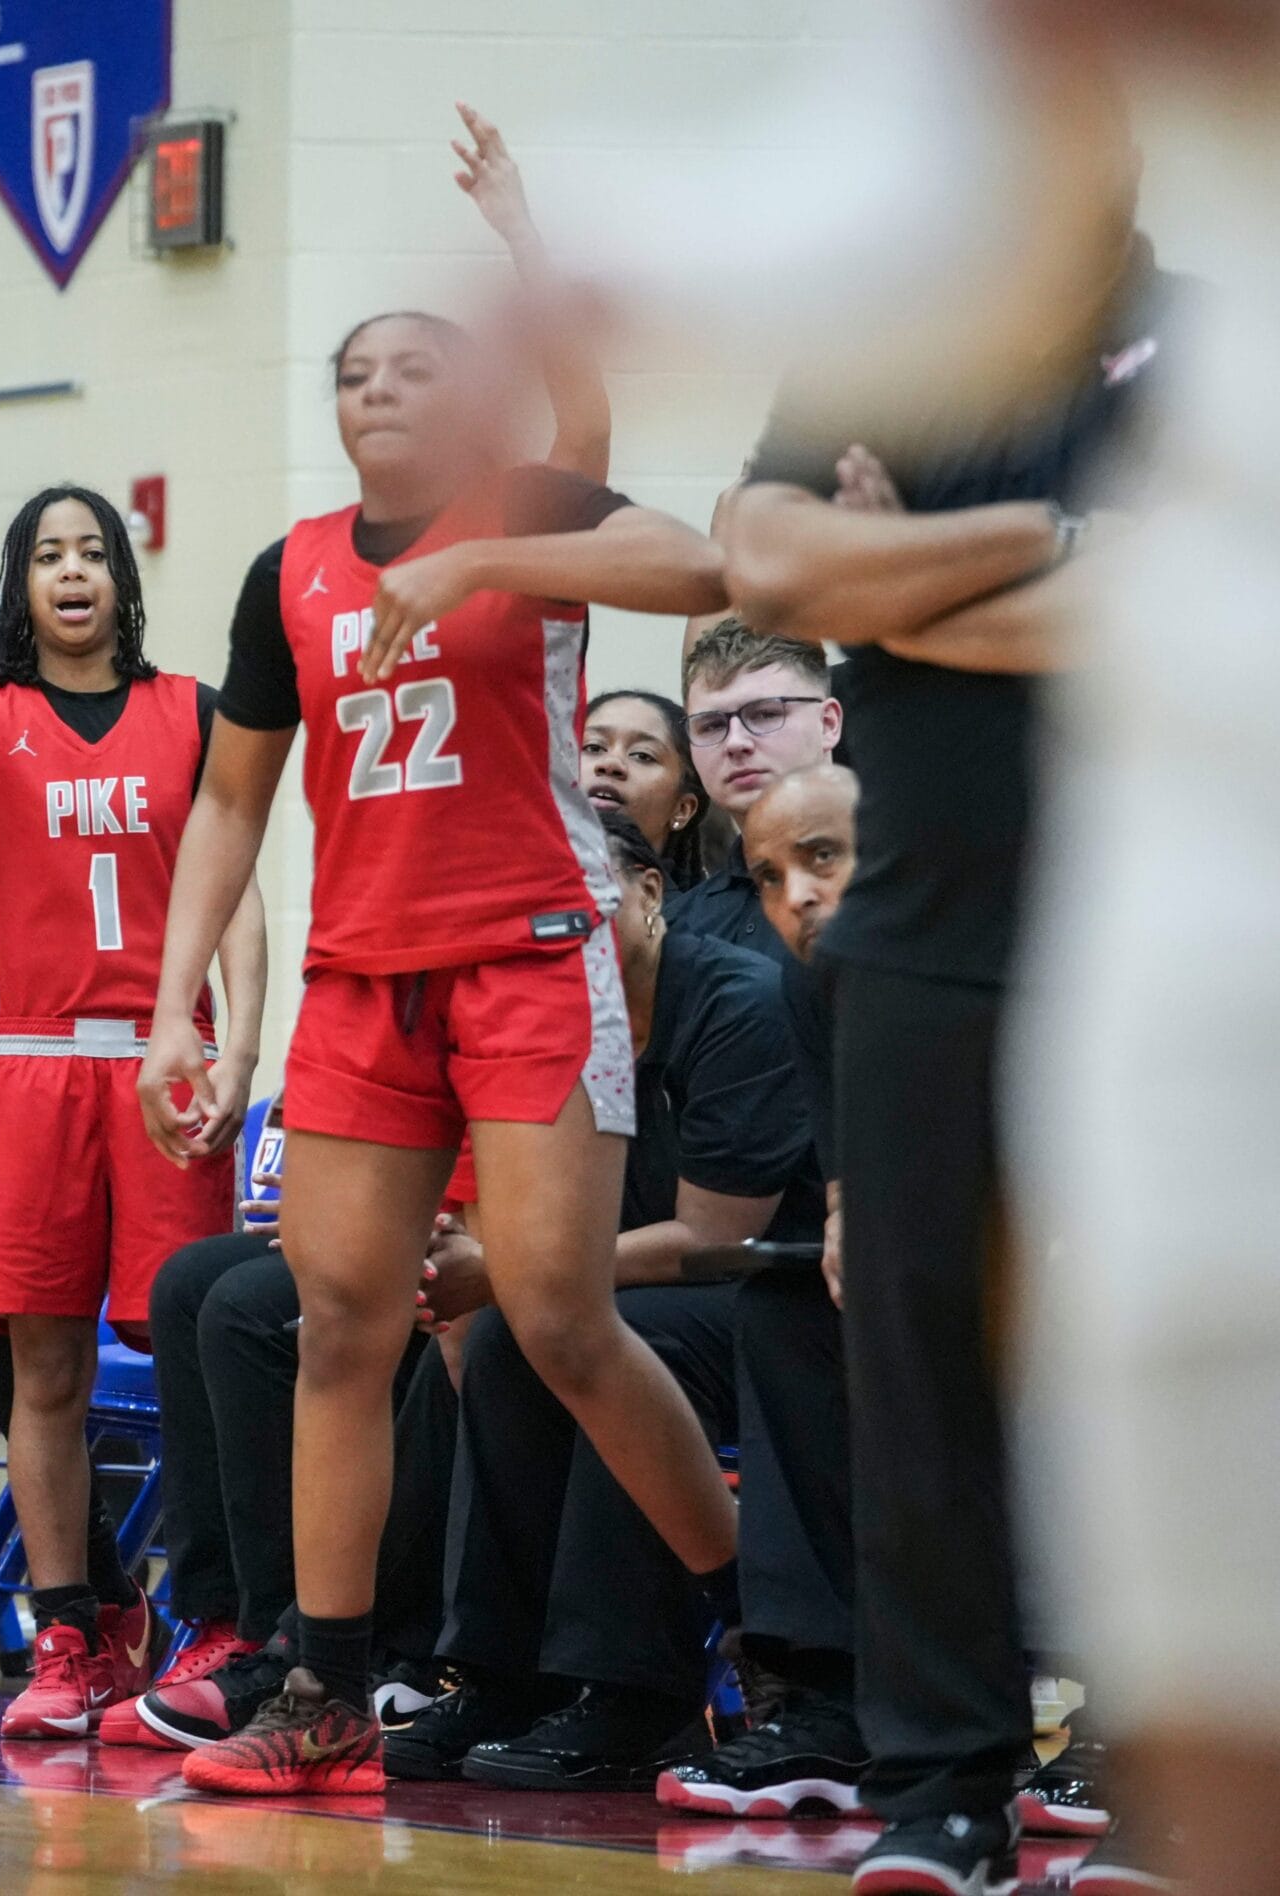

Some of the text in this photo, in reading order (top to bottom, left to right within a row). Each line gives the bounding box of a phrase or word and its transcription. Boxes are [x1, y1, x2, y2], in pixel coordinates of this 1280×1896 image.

[331, 607, 441, 678] PIE
[336, 676, 464, 801] 22
[45, 776, 150, 838] PIKE
[88, 852, 124, 951] 1
